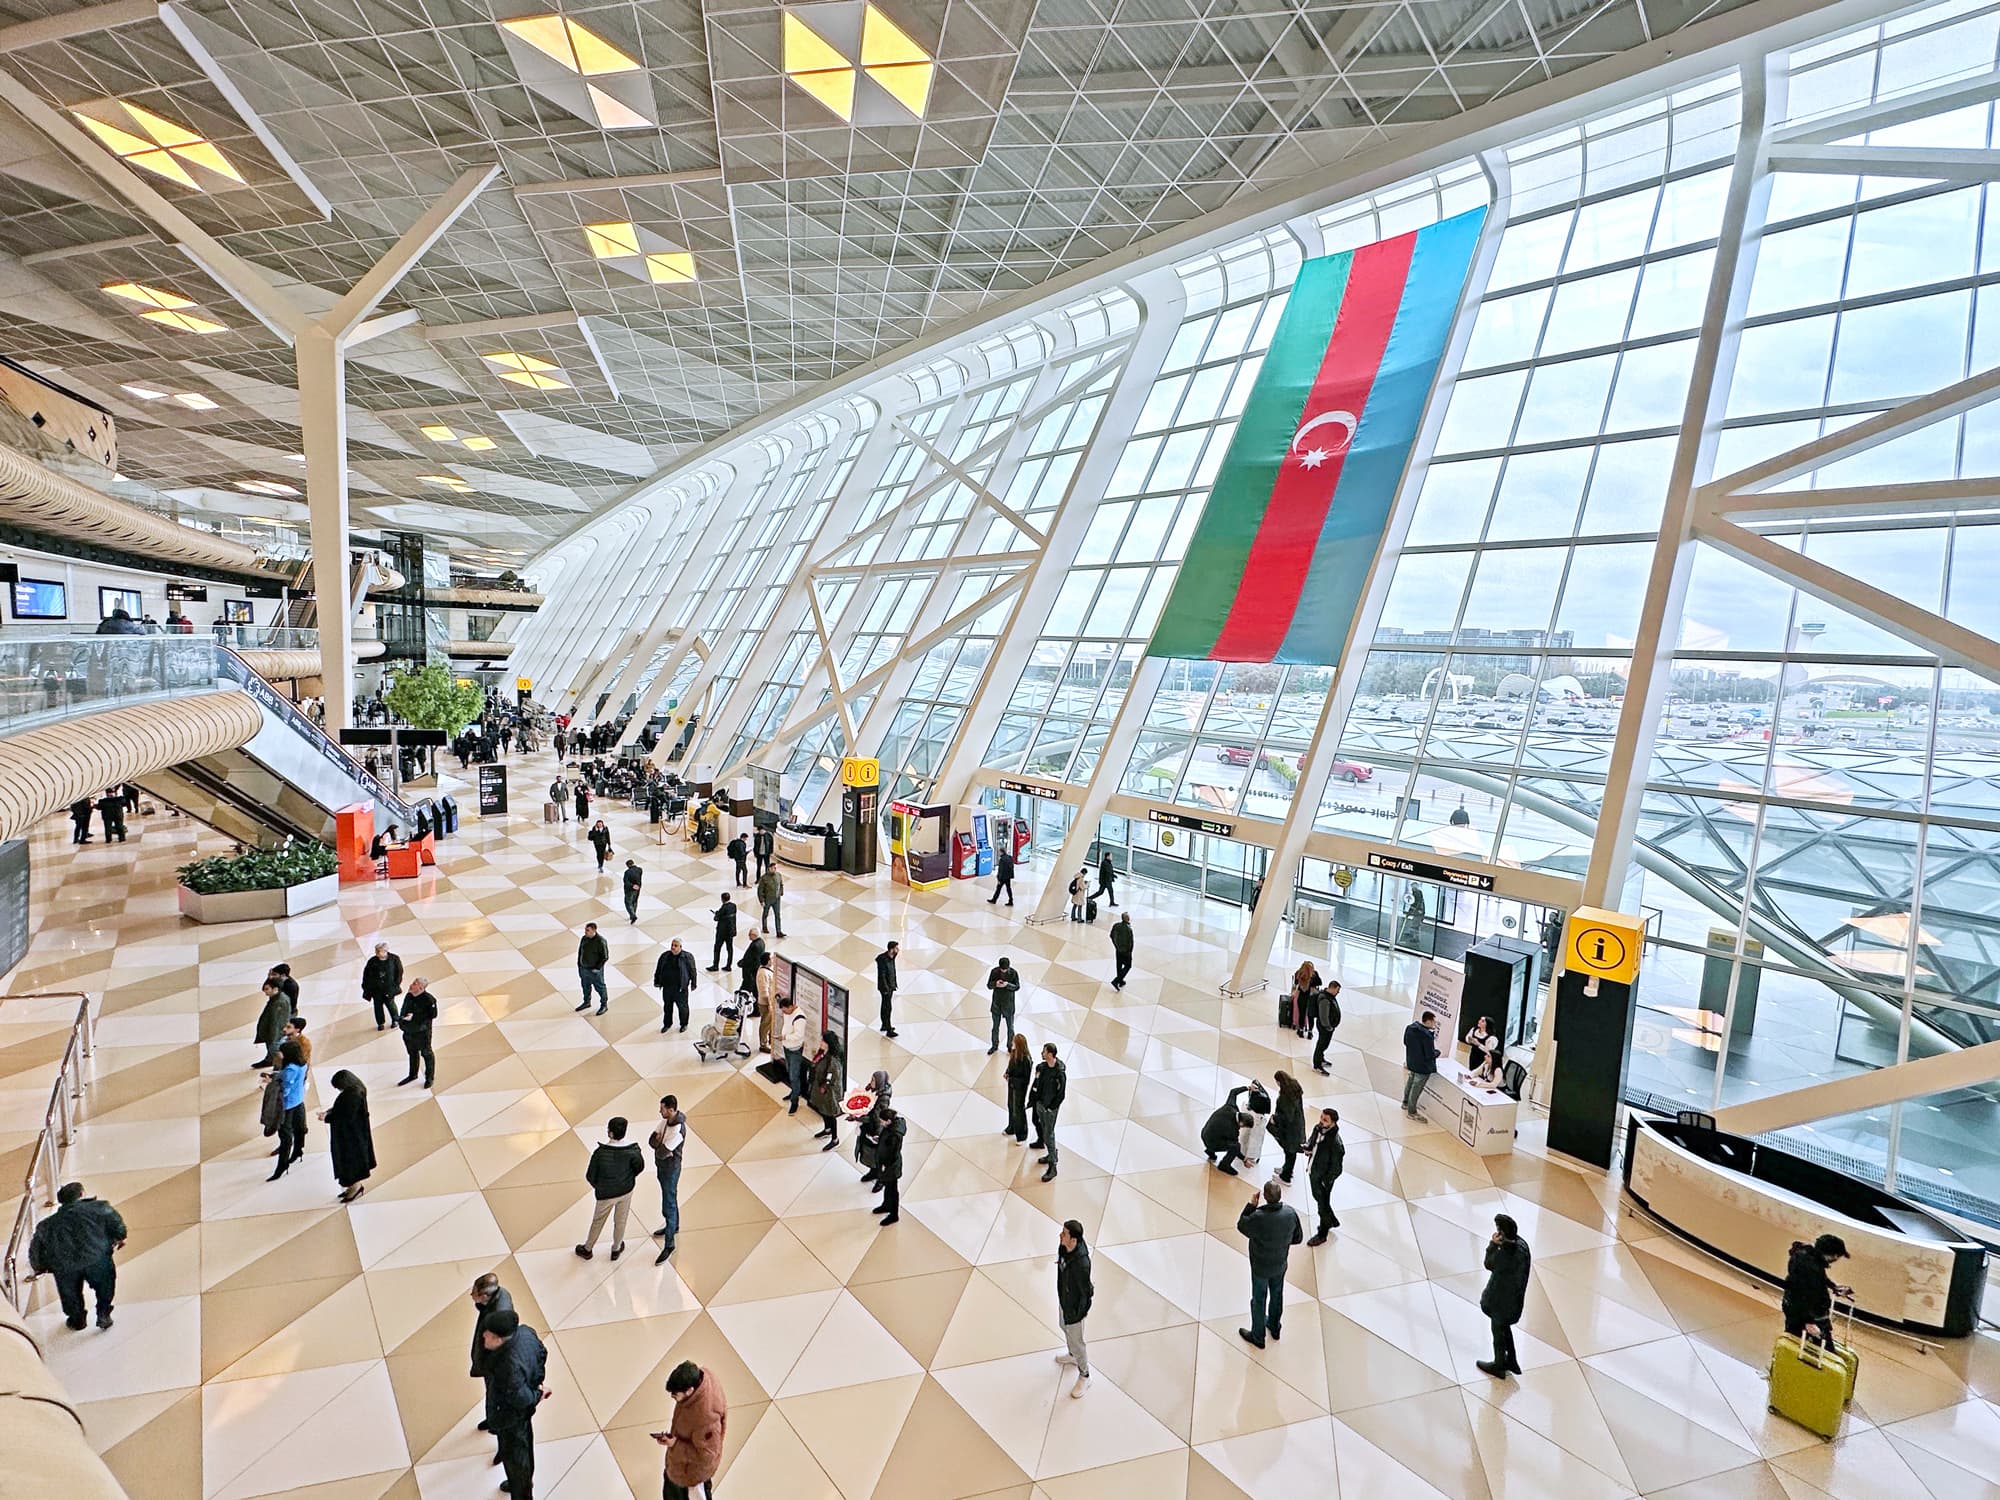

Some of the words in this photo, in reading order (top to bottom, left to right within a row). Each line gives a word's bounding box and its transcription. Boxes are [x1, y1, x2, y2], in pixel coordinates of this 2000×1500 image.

[260, 688, 274, 705] ABB
[1215, 825, 1221, 833] 2
[1401, 862, 1414, 871] Exit
[1592, 937, 1608, 962] i
